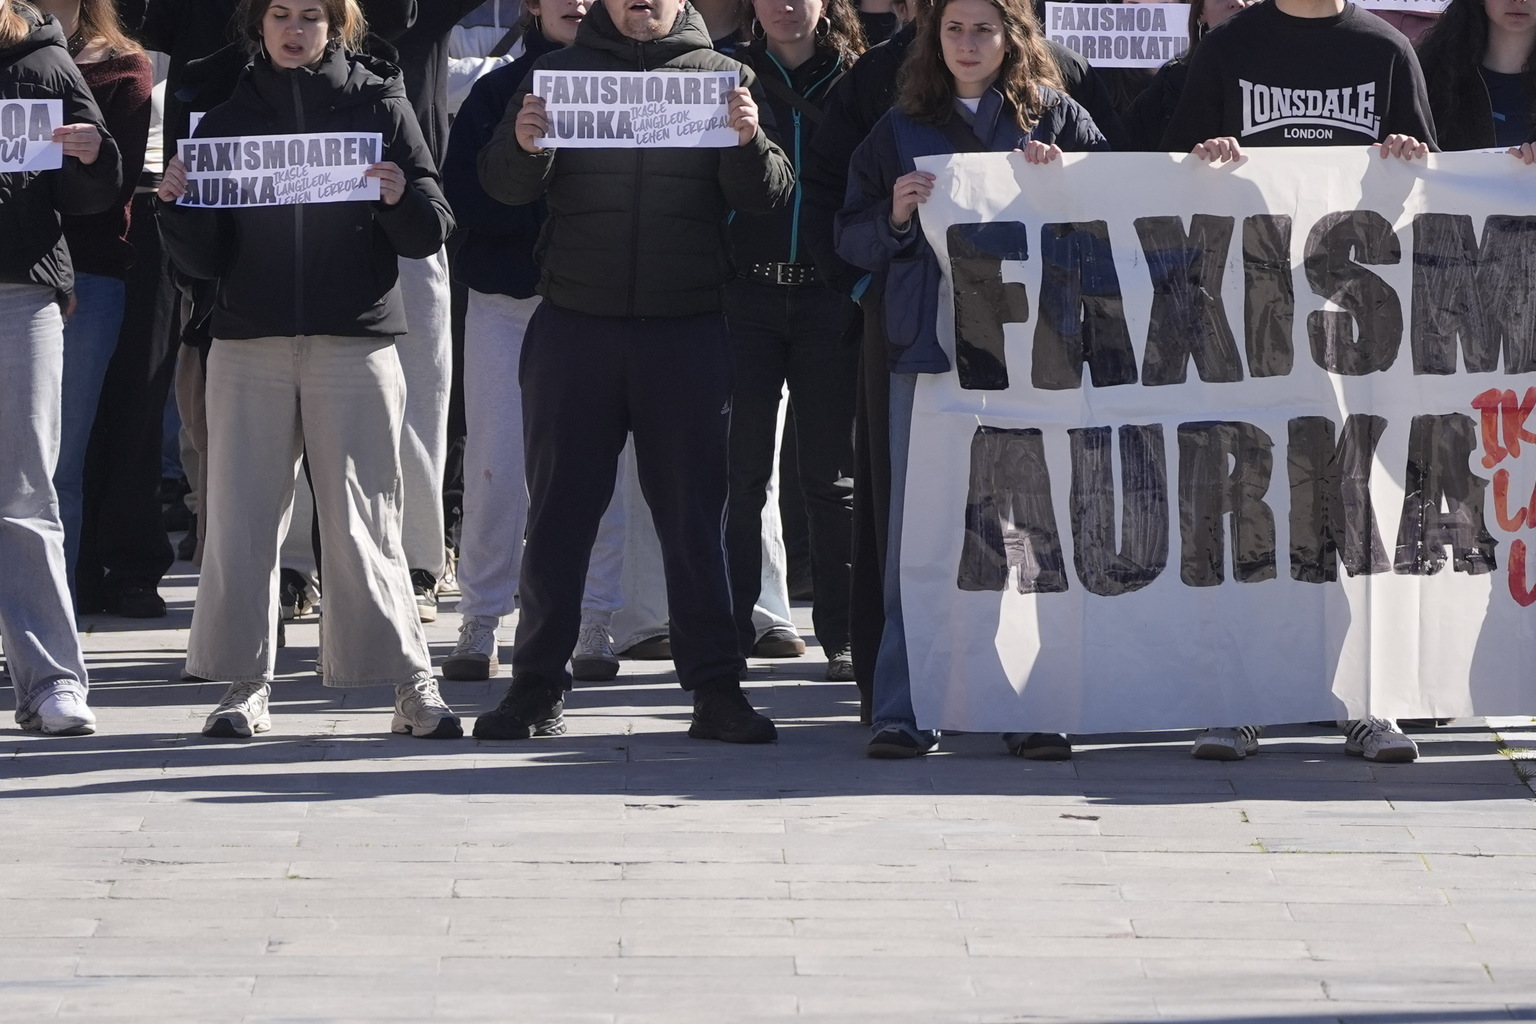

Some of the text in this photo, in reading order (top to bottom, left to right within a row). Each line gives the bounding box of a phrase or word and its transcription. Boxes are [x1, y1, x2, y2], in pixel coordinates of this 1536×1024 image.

[1052, 6, 1167, 32] FAXISMOA
[539, 76, 735, 104] FAXISMOAREN
[629, 101, 667, 120] IKASLE
[631, 110, 690, 133] LANGILEOK
[1239, 79, 1377, 138] LONSDALE
[543, 110, 635, 139] AURKA
[636, 114, 729, 145] LEHEN LERRORA!
[1284, 128, 1333, 139] LONDON
[183, 137, 377, 172] FAXISMOAREN
[273, 164, 309, 184] IKASLE
[275, 172, 331, 197] LANGILEOK
[182, 175, 277, 206] AURKA
[278, 176, 368, 205] LEHEN LERRORA!
[957, 413, 1498, 596] AURKA
